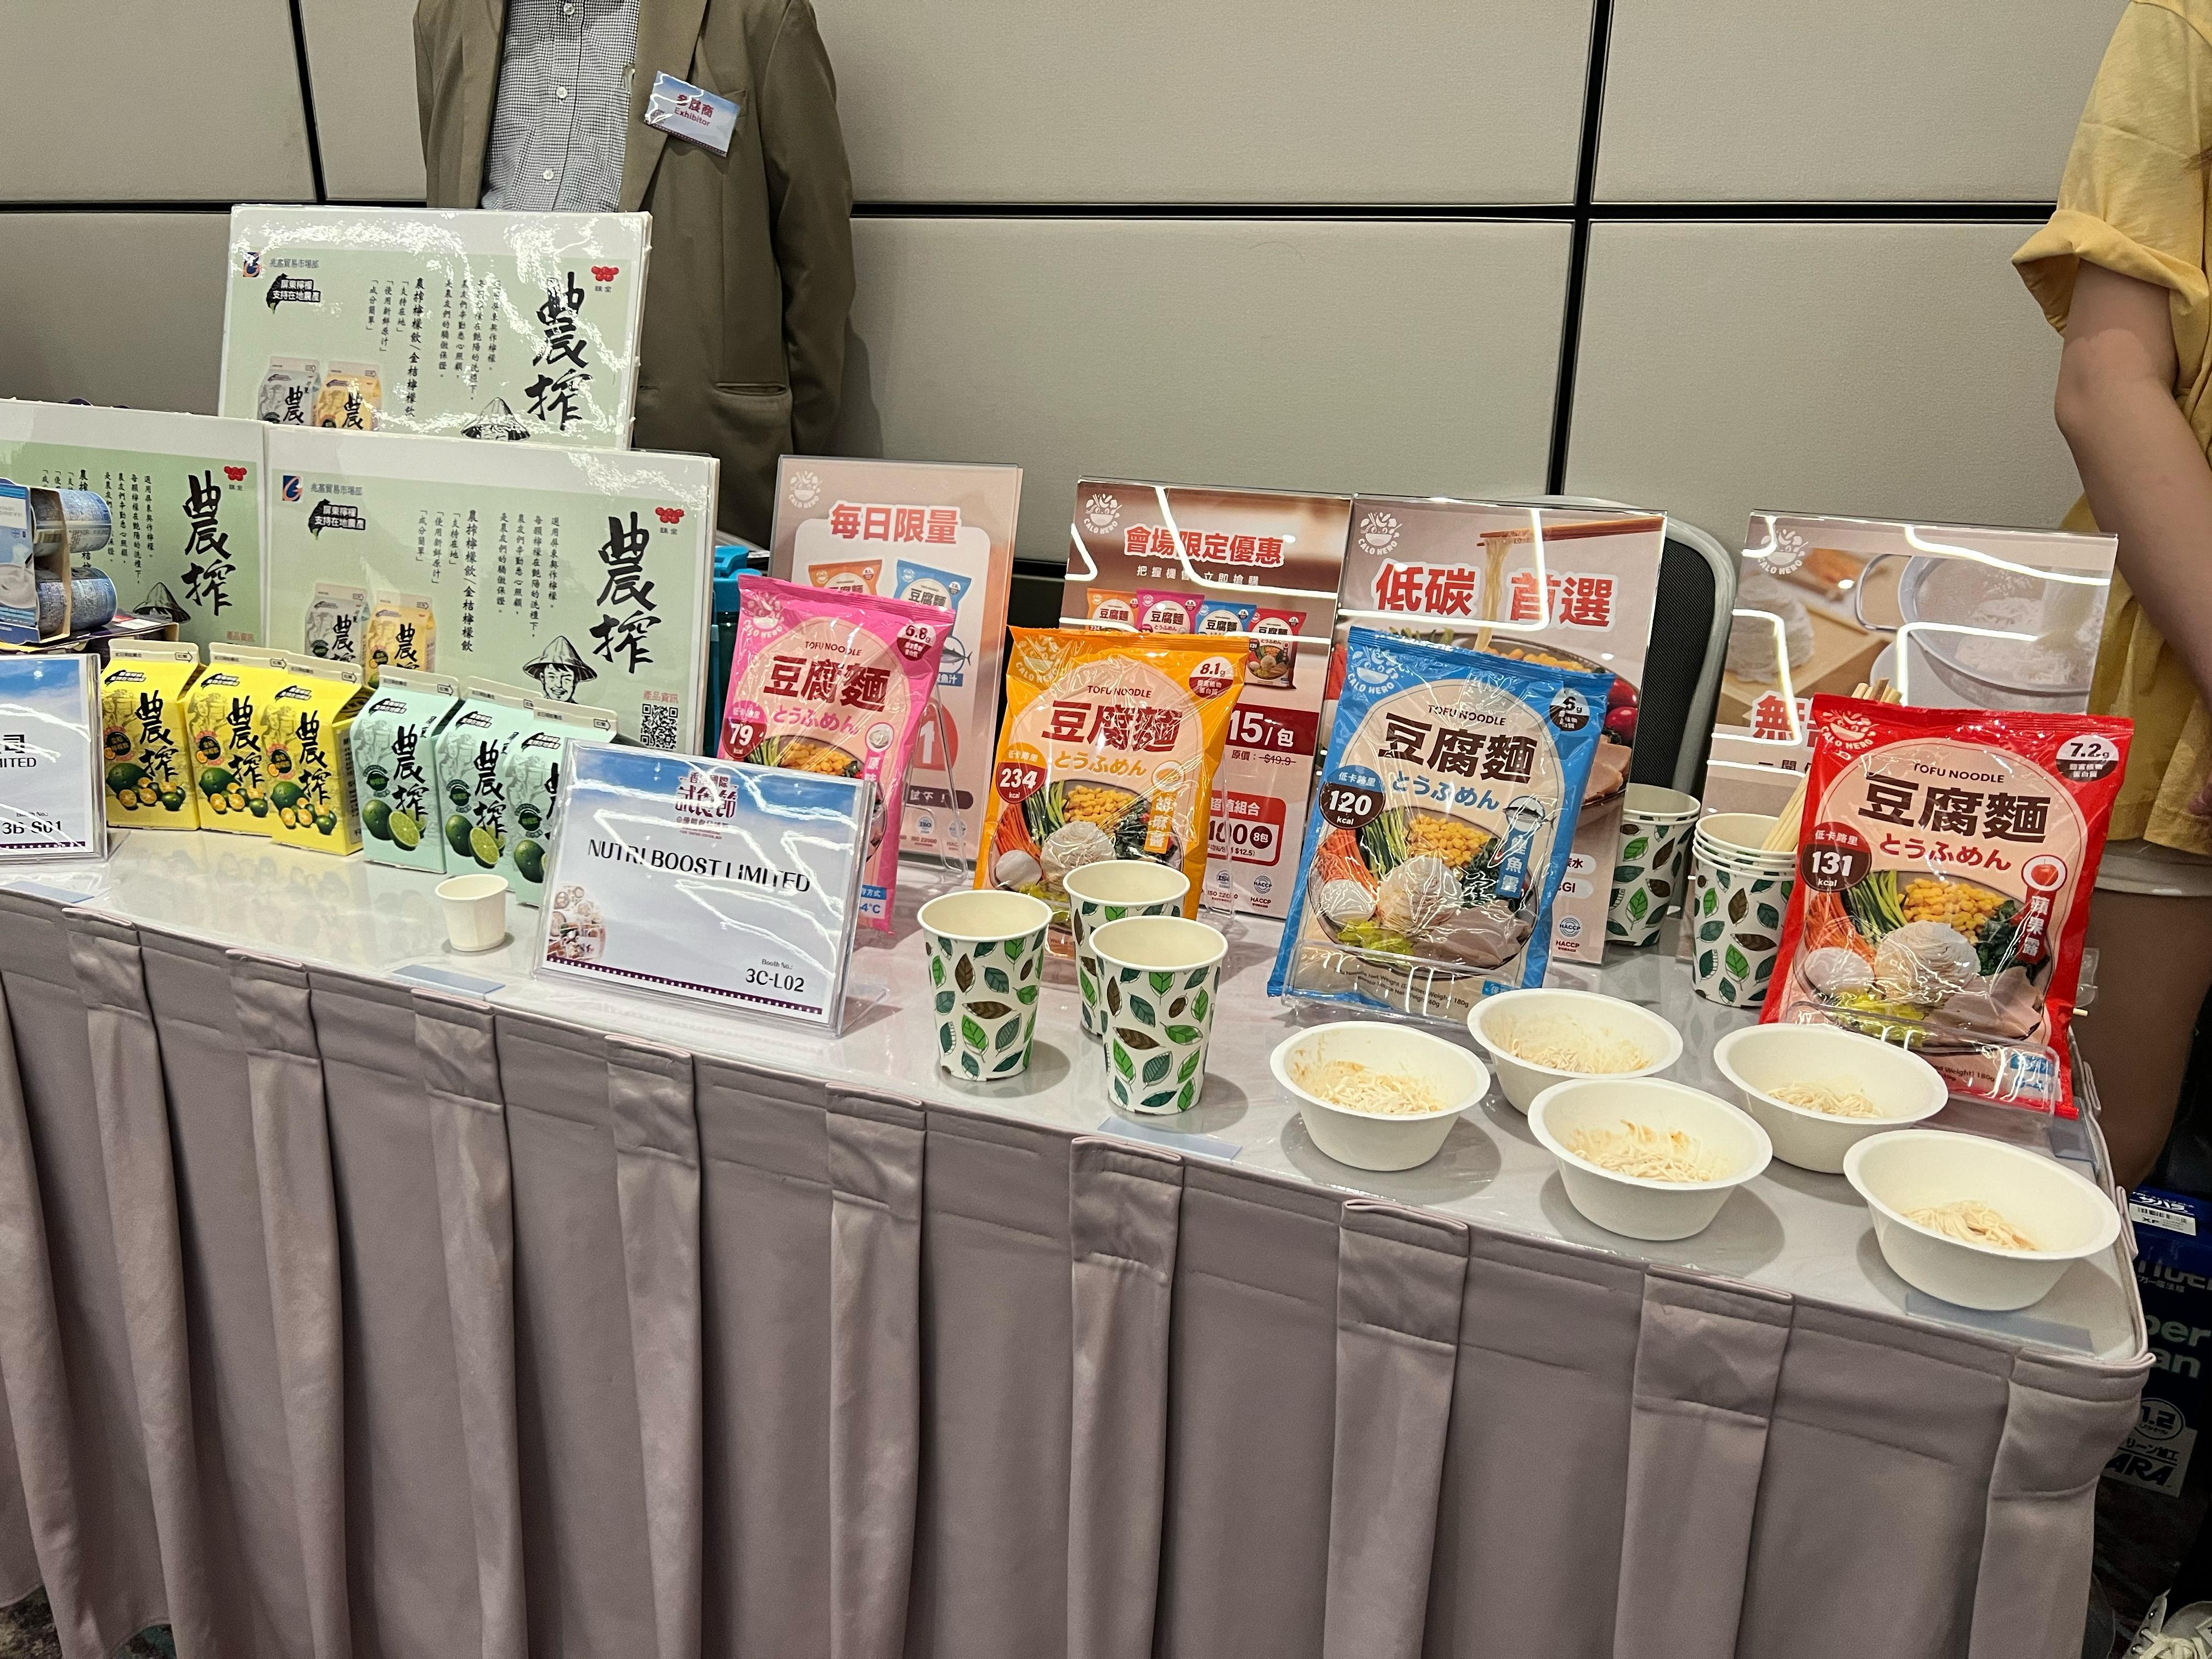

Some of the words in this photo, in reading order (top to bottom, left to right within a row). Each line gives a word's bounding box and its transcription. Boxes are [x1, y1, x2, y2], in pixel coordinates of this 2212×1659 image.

[674, 107, 711, 127] Exhibitor
[831, 504, 959, 544] 每日限量
[1084, 517, 1099, 534] CALO
[1099, 520, 1118, 534] HERO
[180, 470, 236, 617] 農榨
[1126, 526, 1284, 565] 會場限定優惠
[1357, 537, 1374, 555] CALO
[1376, 540, 1398, 556] HERO
[1778, 558, 1803, 575] HERO
[589, 511, 662, 674] 農榨
[1375, 563, 1476, 616] 低碳
[1508, 571, 1614, 628] 首選
[1099, 608, 1129, 621] 豆腐麵
[1150, 611, 1184, 625] 豆腐麵
[760, 625, 783, 639] HERO
[805, 640, 823, 650] TOFU
[1015, 661, 1035, 682] CALO
[1200, 662, 1226, 678] 8.1g
[763, 654, 891, 713] 豆腐麵
[1087, 685, 1113, 695] TOFU
[1114, 688, 1153, 698] NOODLE
[1347, 673, 1368, 694] CALO
[1369, 680, 1395, 696] HERO
[643, 690, 679, 704] 產品資訊
[773, 704, 858, 736] とうふめん
[1041, 699, 1184, 753] 豆腐麵
[1427, 704, 1458, 719] TOFU
[1458, 709, 1507, 727] NOODLE
[135, 690, 179, 782] 農榨
[225, 695, 264, 788] 農榨
[730, 723, 754, 746] 79
[1820, 725, 1843, 747] CALO
[1845, 738, 1874, 750] HERO
[295, 710, 332, 805] 農榨
[1378, 712, 1538, 785] 豆腐麵
[2070, 742, 2110, 759] 7.2g
[0, 757, 37, 768] ITED
[391, 724, 429, 822] 農榨
[1054, 751, 1148, 777] とうふめん
[1912, 761, 1945, 776] TOFU
[1948, 769, 2005, 784] NOODLE
[473, 739, 508, 839] 農榨
[1000, 768, 1038, 789] 234
[1338, 771, 1376, 787] 低卡路里
[1392, 770, 1500, 812] とうふめん
[1329, 790, 1372, 816] 120
[1858, 771, 2051, 844] 豆腐麵
[2, 821, 62, 834] 3BS01
[1336, 816, 1355, 825] kcal
[1252, 832, 1269, 843] 8包
[1815, 829, 1858, 846] 低卡路里
[588, 839, 646, 865] NUTRI
[651, 850, 723, 878] BOOST
[1879, 832, 2012, 872] とうふめん
[1812, 851, 1853, 877] 131
[1559, 882, 1576, 893] GI
[1818, 878, 1837, 887] kcal
[1250, 896, 1272, 905] HACCP
[1555, 940, 1580, 949] HACCP
[761, 958, 780, 967] Booth
[746, 968, 805, 992] 3C-L02
[1454, 997, 1469, 1008] 180g
